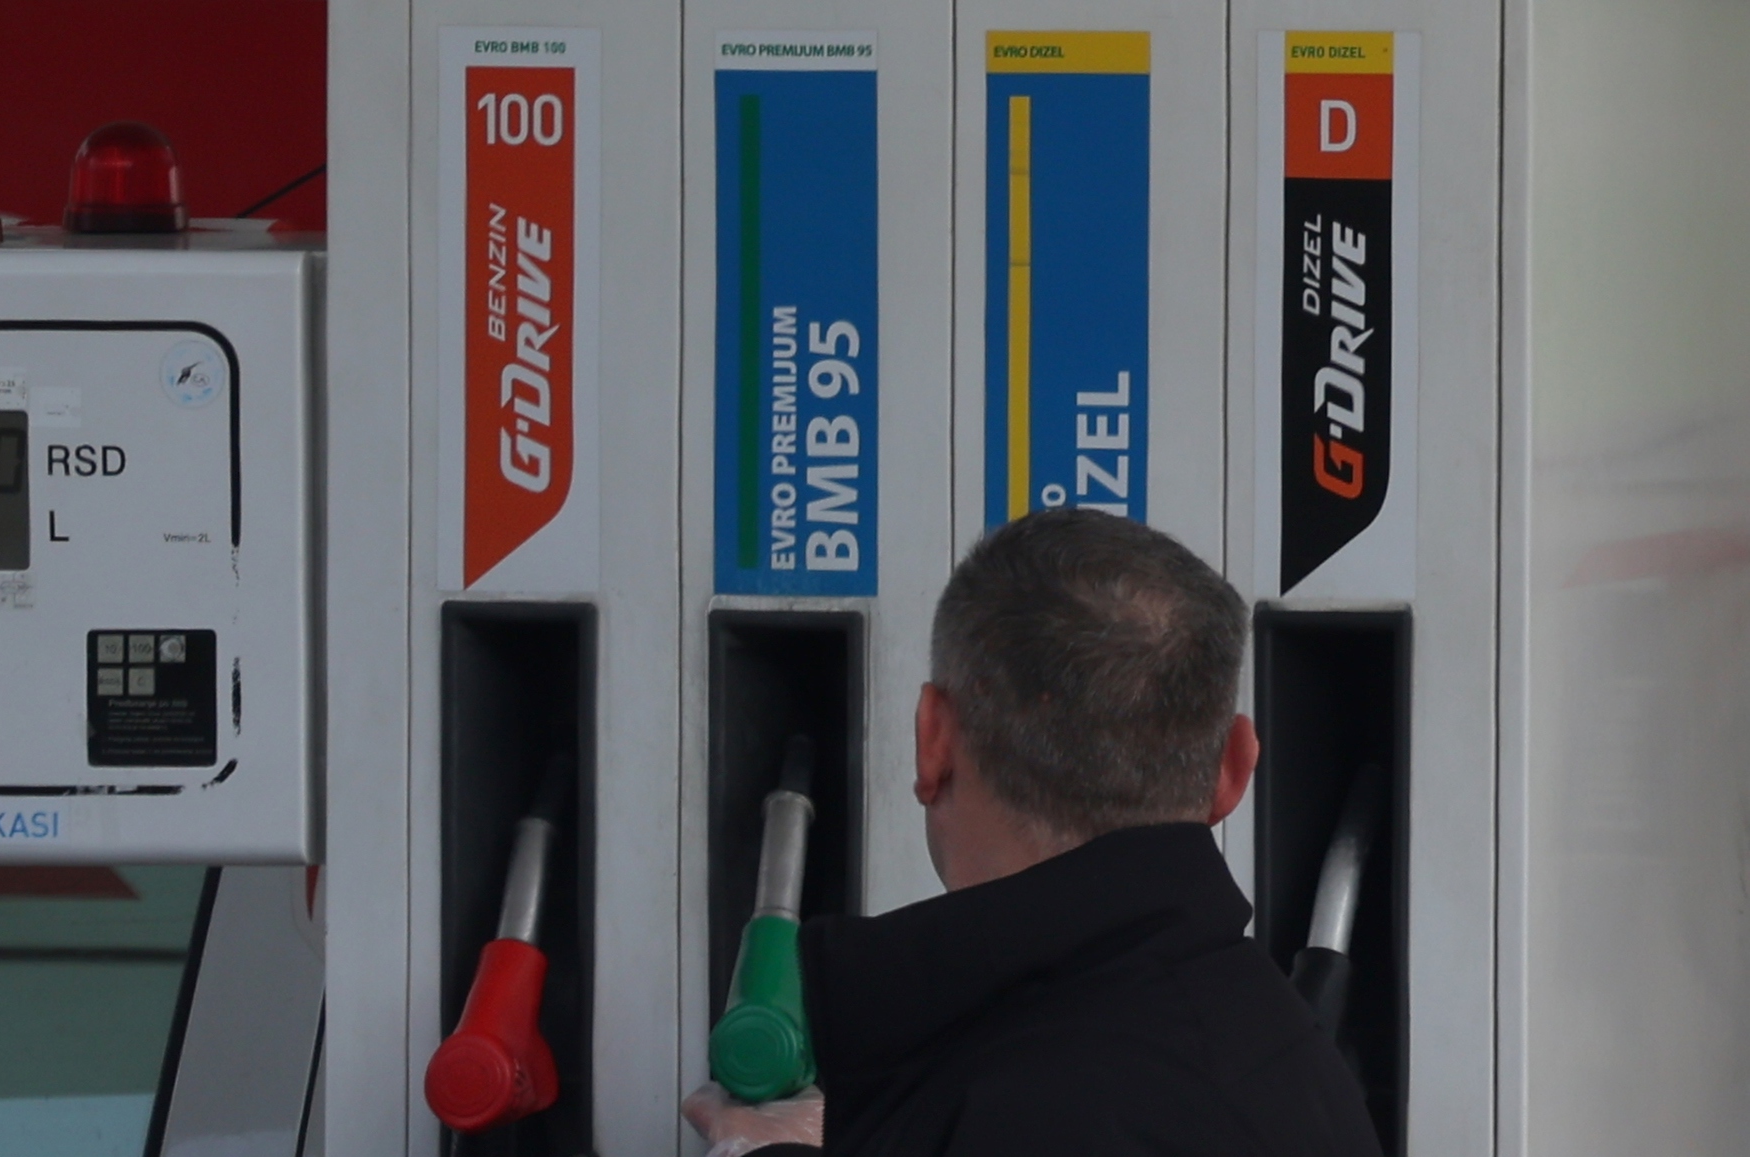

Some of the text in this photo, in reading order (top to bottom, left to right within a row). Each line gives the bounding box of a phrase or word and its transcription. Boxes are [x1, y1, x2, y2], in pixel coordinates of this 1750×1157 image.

[474, 40, 567, 54] EVRO BMB 100
[721, 43, 757, 56] EVRO
[826, 44, 855, 57] BMB
[856, 44, 873, 57] 95
[993, 45, 1065, 59] EVRO DIZEL
[1291, 46, 1367, 59] EVRO DIZEL
[477, 92, 563, 147] 100
[1319, 98, 1358, 152] D
[488, 202, 507, 342] BENZIN
[1302, 212, 1322, 316] DIZEL
[47, 445, 127, 477] RSD
[770, 306, 798, 571] EVRO PREMIJUM
[805, 320, 861, 571] BMB 95
[1076, 370, 1131, 518] IZEL
[49, 510, 70, 542] L
